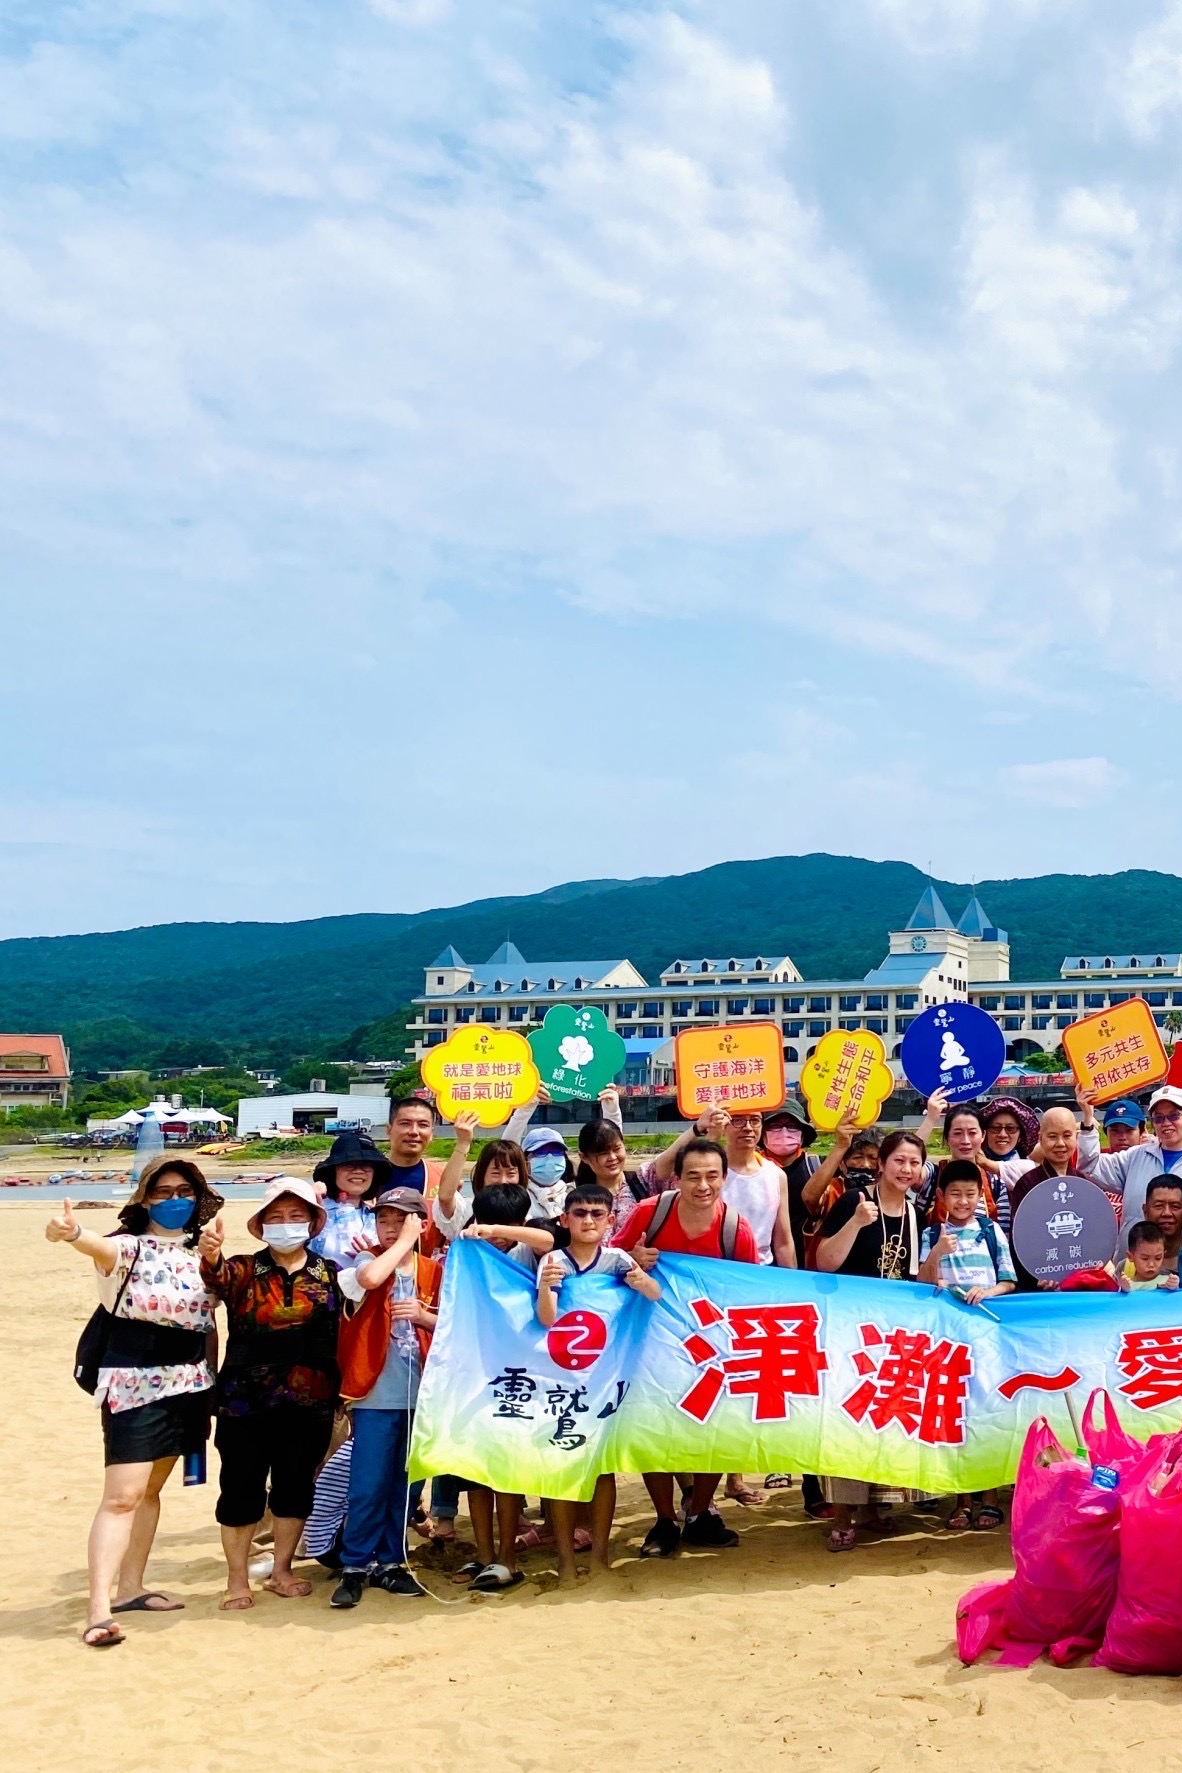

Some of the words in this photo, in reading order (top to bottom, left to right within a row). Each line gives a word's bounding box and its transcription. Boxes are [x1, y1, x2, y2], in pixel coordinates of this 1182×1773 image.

[1085, 1034, 1145, 1070] 多元共生
[443, 1062, 522, 1078] 就是愛地球
[694, 1058, 765, 1079] 守護海洋
[824, 1040, 860, 1112] 靈性生態
[1092, 1055, 1151, 1090] 相依共存
[451, 1082, 513, 1101] 福氣啦
[545, 1083, 592, 1100] eforestation
[844, 1048, 877, 1117] 生命和平
[957, 1081, 983, 1093] peace
[696, 1082, 767, 1104] 愛護地球
[1045, 1245, 1083, 1262] 減碳
[1034, 1262, 1064, 1274] carbon
[1065, 1258, 1104, 1271] reduction
